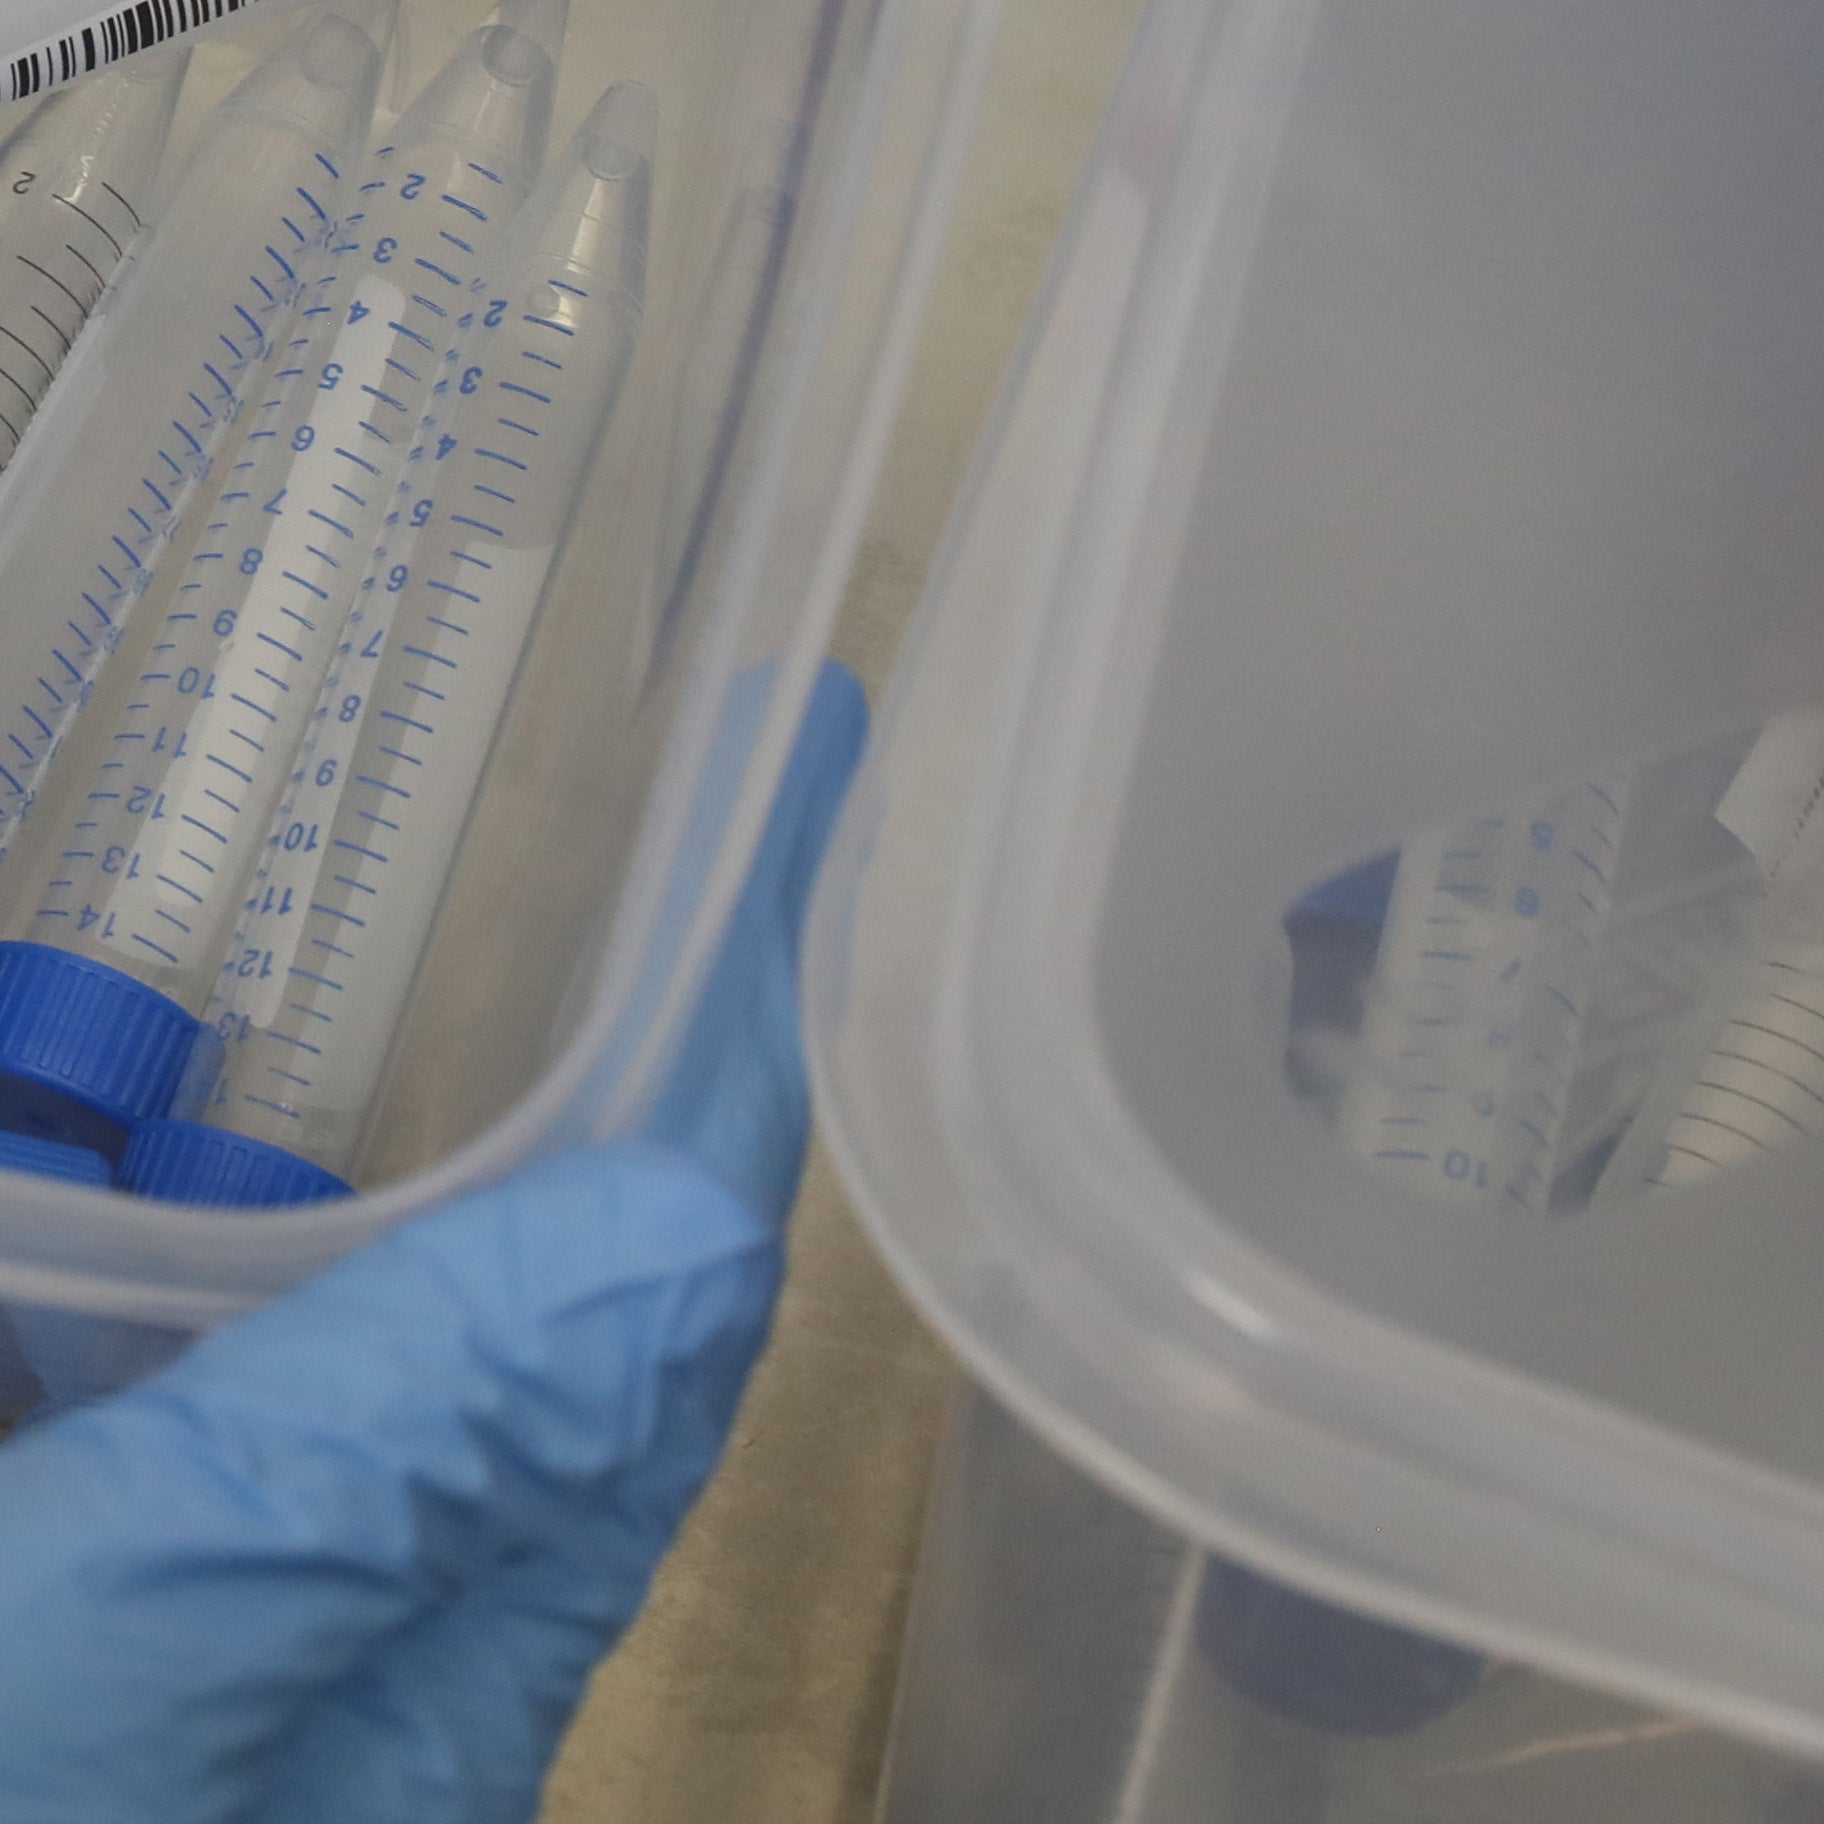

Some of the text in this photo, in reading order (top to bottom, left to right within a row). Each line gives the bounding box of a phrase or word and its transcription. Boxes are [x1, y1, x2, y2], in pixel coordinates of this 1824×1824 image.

[13, 172, 36, 194] 2
[401, 173, 426, 199] 2
[373, 237, 398, 263] 3
[347, 301, 370, 324] 4
[483, 300, 508, 327] 2
[319, 363, 344, 390] 5
[459, 367, 483, 394] 3
[291, 425, 315, 451] 6
[436, 434, 458, 460] 4
[263, 489, 288, 515] 7
[409, 499, 434, 527] 5
[240, 548, 263, 574] 8
[385, 564, 409, 592] 6
[212, 610, 238, 637] 9
[360, 630, 383, 658] 7
[177, 667, 216, 699] 10
[338, 695, 362, 723] 8
[152, 727, 188, 758] 11
[315, 759, 338, 787] 9
[127, 785, 166, 820] 12
[284, 822, 319, 853] 10
[101, 846, 140, 879] 13
[261, 886, 294, 916] 11
[77, 904, 117, 938] 14
[238, 949, 274, 979] 12
